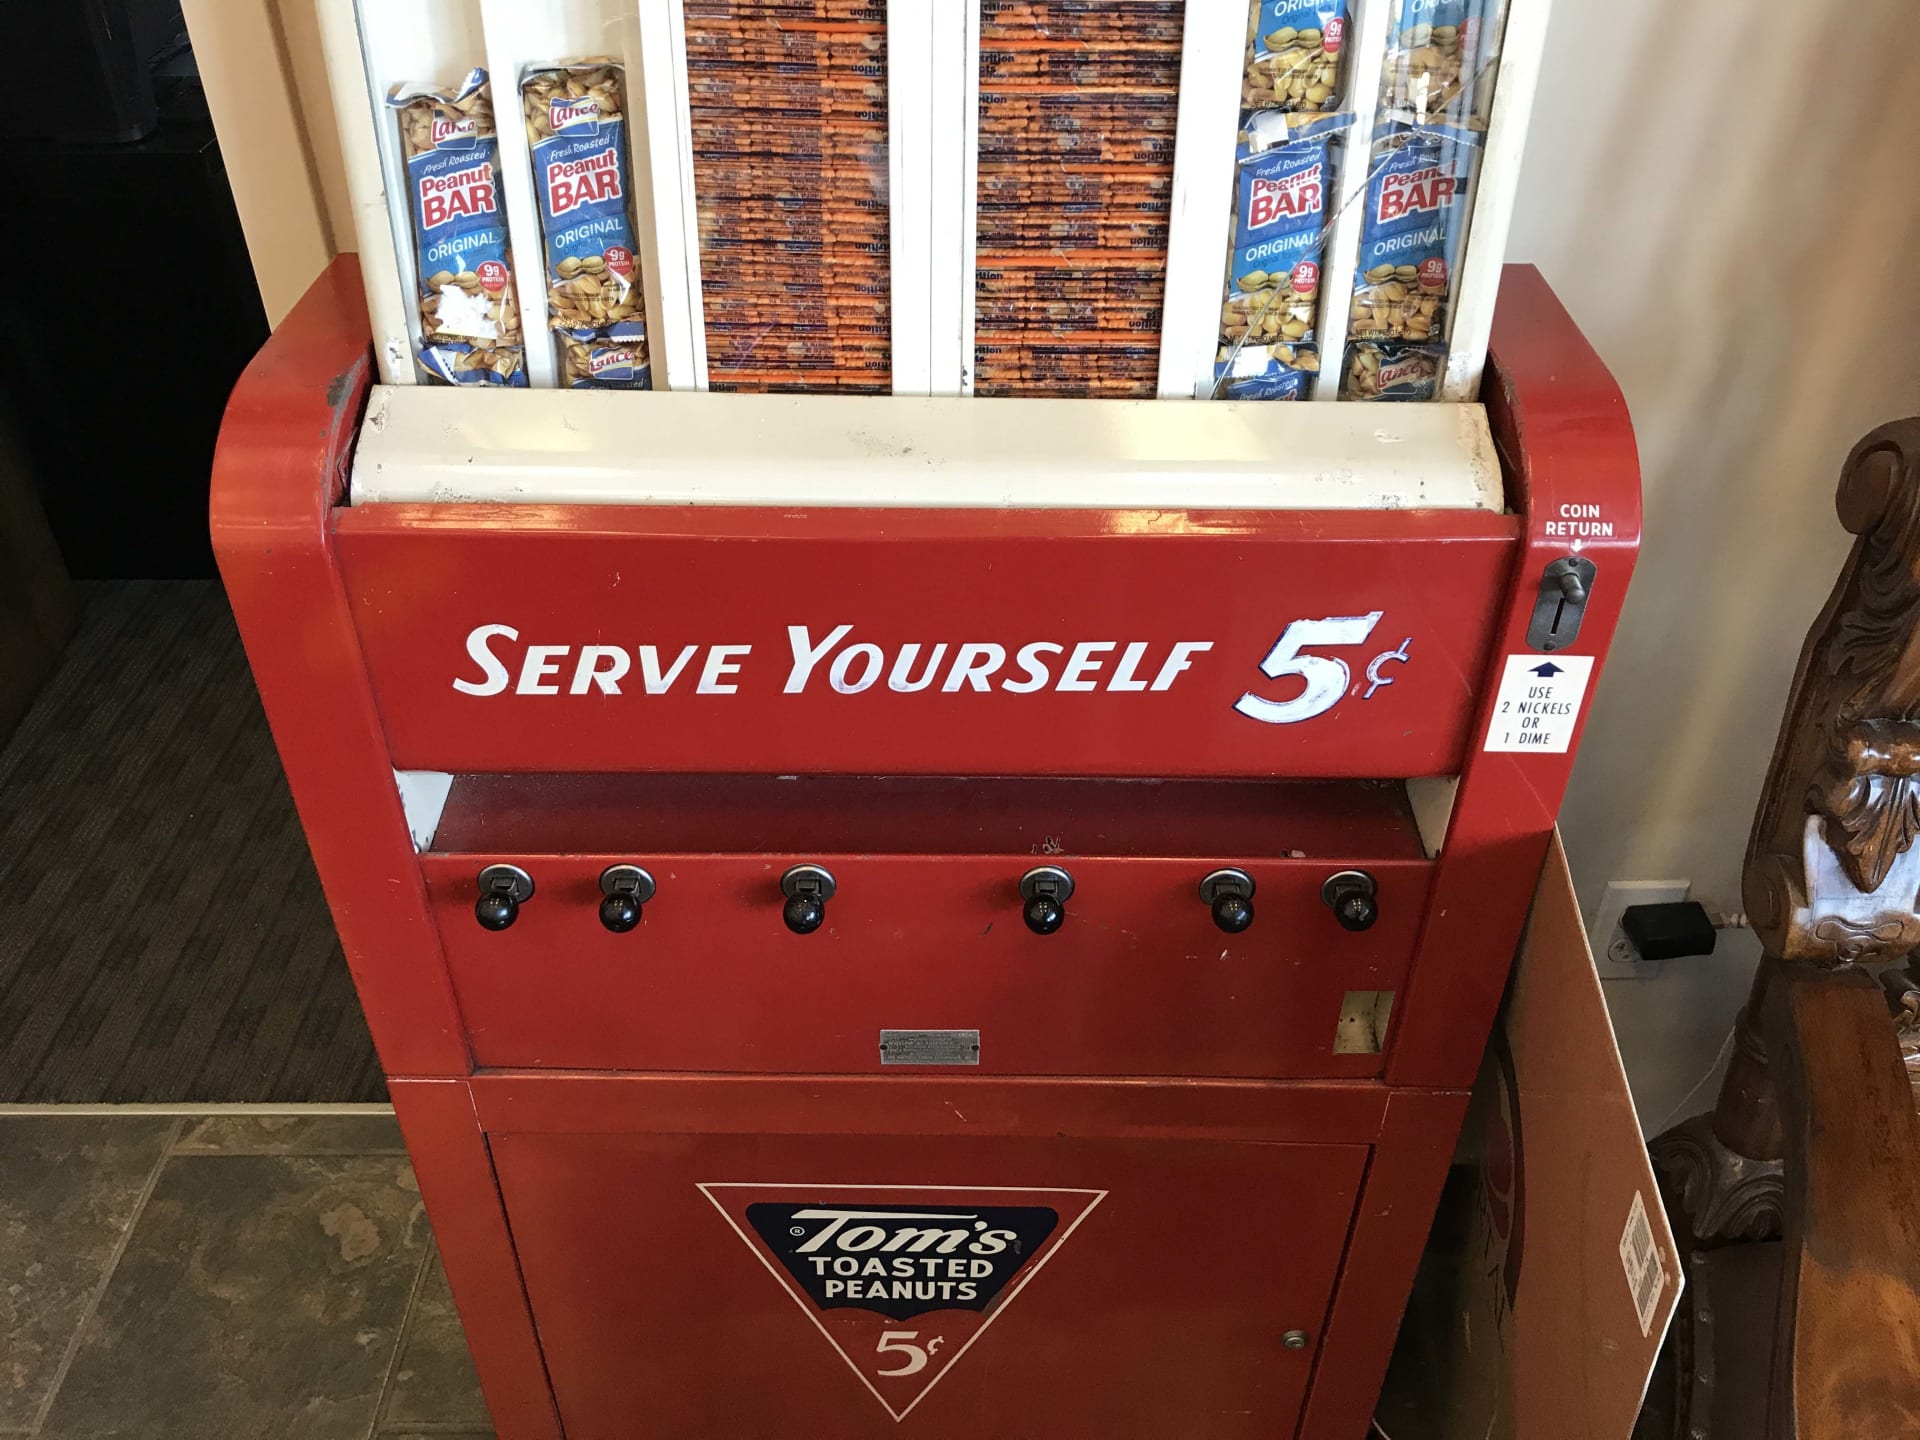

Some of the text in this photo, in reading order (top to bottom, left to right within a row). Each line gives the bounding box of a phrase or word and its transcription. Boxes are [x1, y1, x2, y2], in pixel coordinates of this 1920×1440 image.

[549, 103, 600, 130] Lance
[550, 134, 610, 161] Fresh Roasted
[423, 149, 486, 175] Fresh Roasted
[549, 149, 617, 184] Peanut
[1255, 151, 1321, 177] Fresh Roasted
[1388, 156, 1416, 172] Fresh
[421, 164, 492, 197] Peanut
[550, 169, 620, 214] BAR
[1252, 162, 1322, 197] Peanut
[423, 184, 495, 228] BAR
[1249, 183, 1320, 227] BAR
[1379, 177, 1456, 221] BAR
[428, 231, 497, 262] ORIGINAL
[555, 219, 624, 249] ORIGINAL
[1245, 231, 1319, 262] ORIGINAL
[1373, 227, 1447, 256] ORIGINAL
[609, 249, 625, 261] 9g
[1427, 260, 1443, 273] 9g
[484, 264, 500, 277] 9g
[1298, 264, 1314, 278] 9g
[589, 351, 634, 373] Lance
[1376, 361, 1424, 389] Lance
[1560, 504, 1600, 518] COIN
[1545, 521, 1613, 537] RETURN
[452, 623, 752, 696] SERVE
[783, 624, 1214, 695] YOURSELF
[1528, 686, 1554, 699] USE
[1501, 701, 1572, 715] 2 NICKELS
[1521, 716, 1540, 729] OR
[1504, 731, 1552, 745] 1 DIME
[791, 1209, 1018, 1255] Tom's
[808, 1256, 994, 1278] TOASTED
[825, 1279, 977, 1300] PEANUTS
